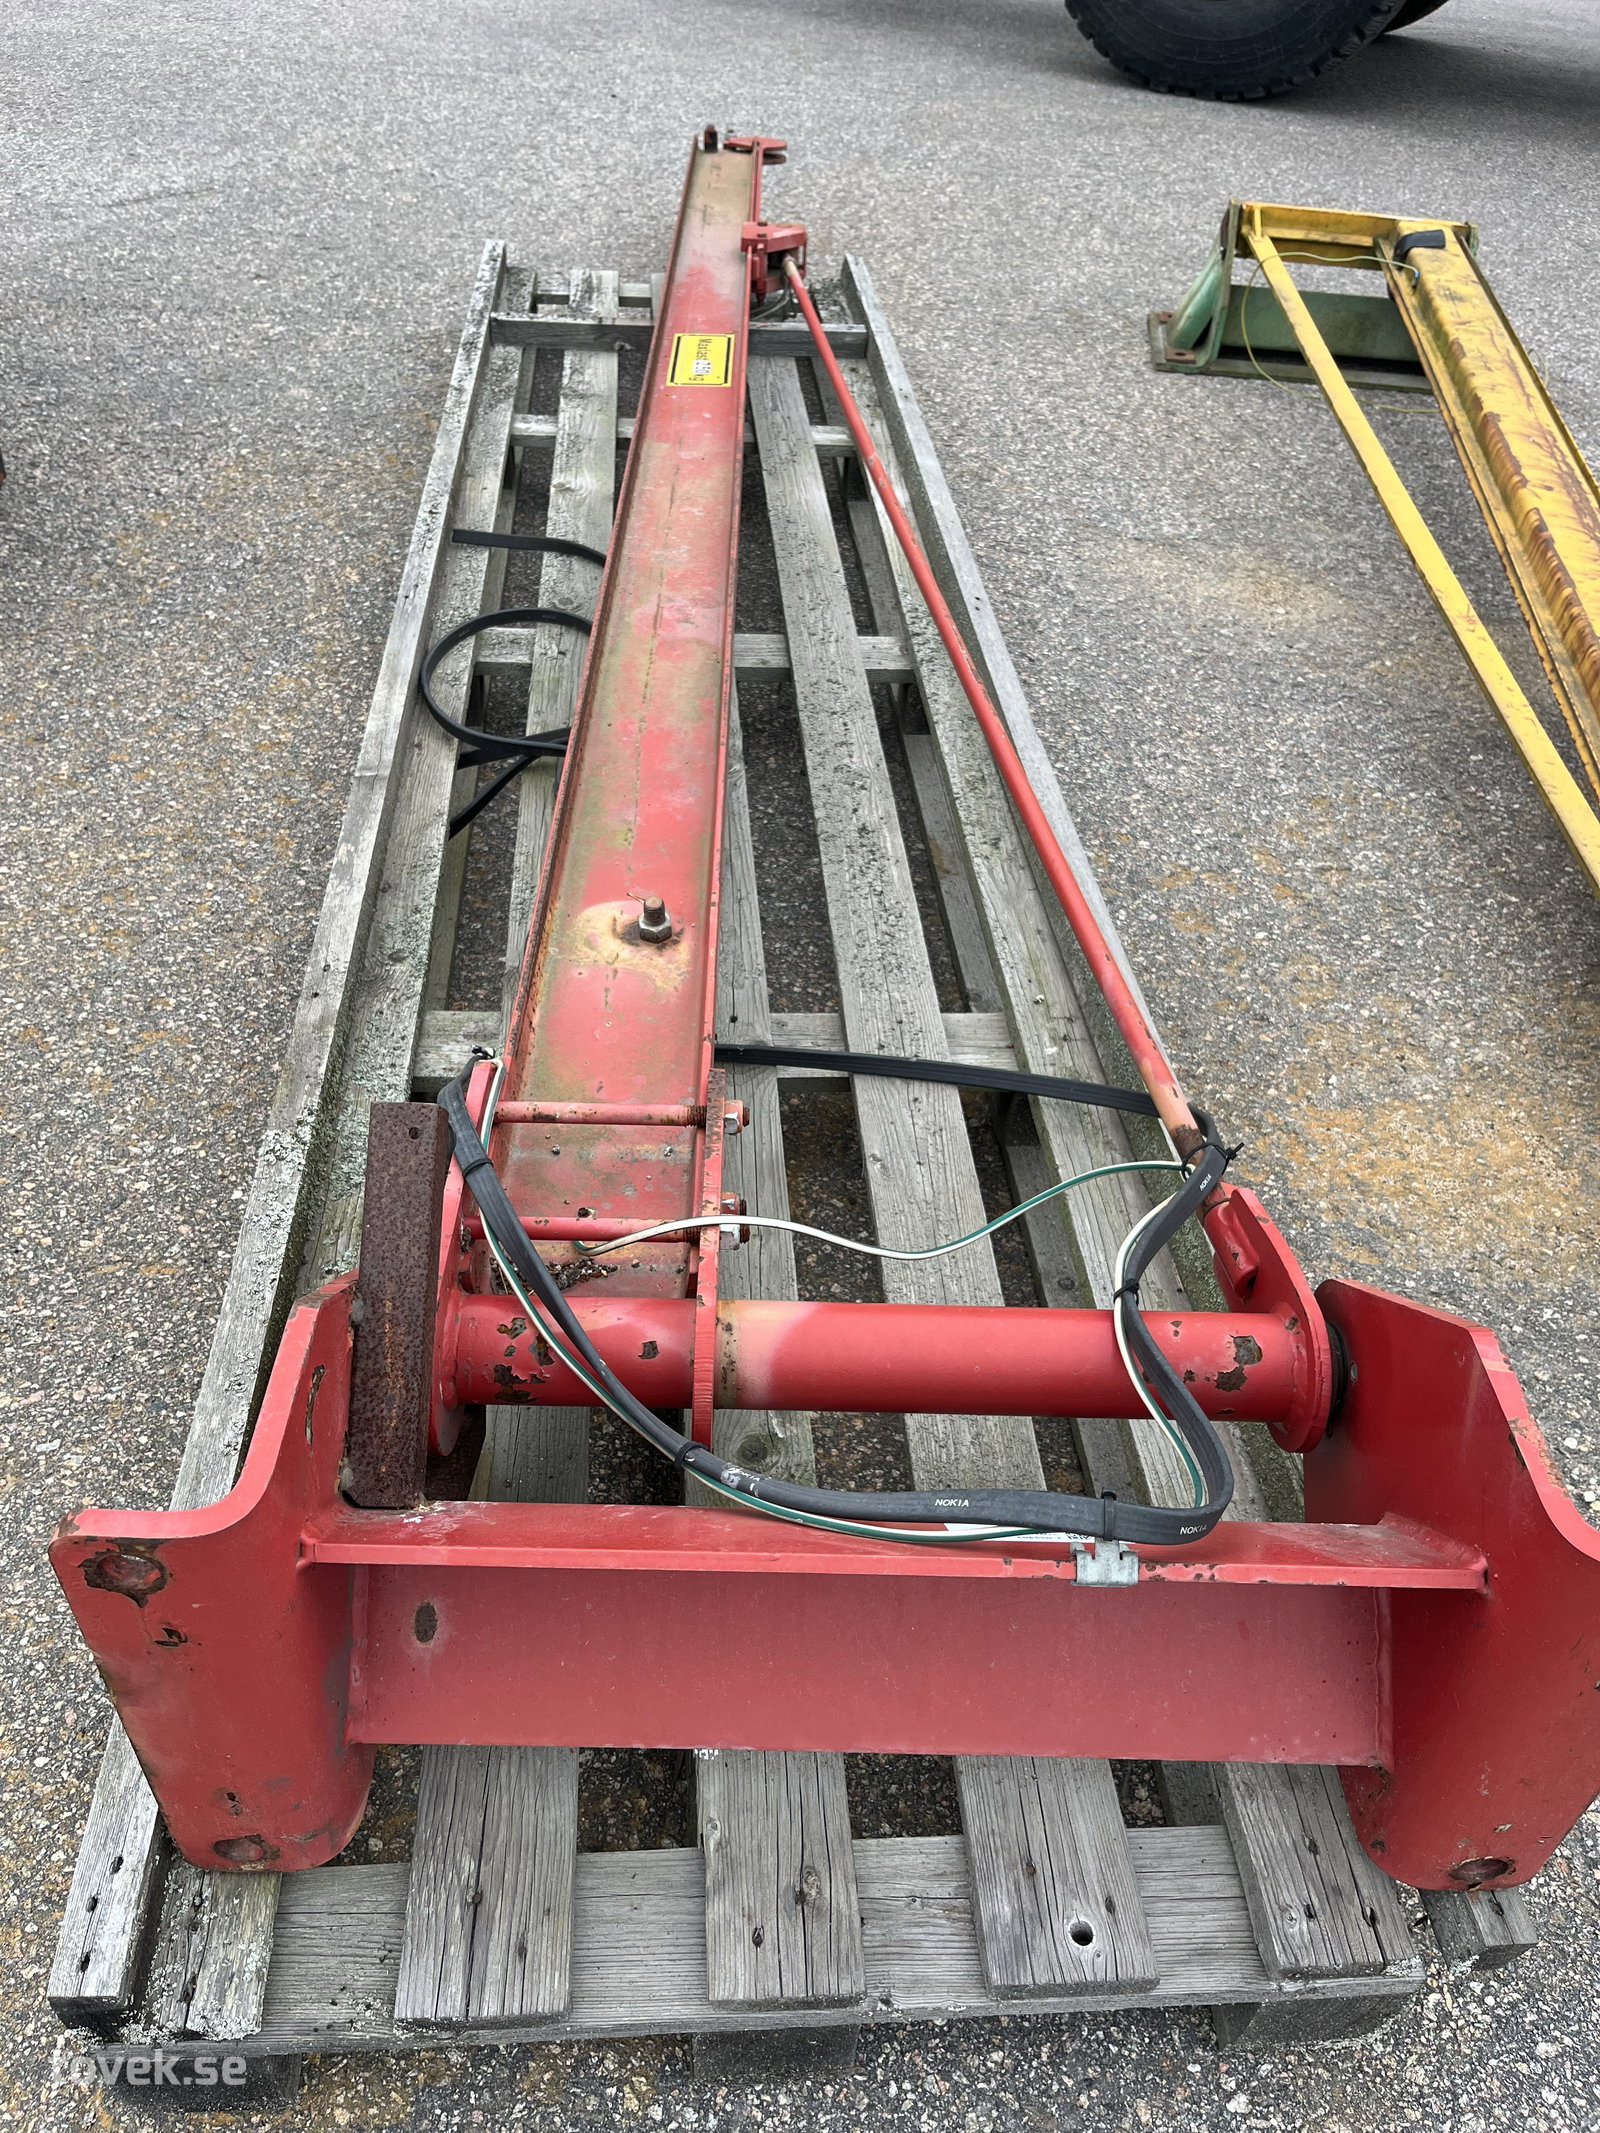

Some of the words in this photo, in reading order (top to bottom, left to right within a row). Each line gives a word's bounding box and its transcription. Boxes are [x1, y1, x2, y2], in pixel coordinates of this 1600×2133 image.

[694, 362, 711, 373] 250
[1199, 1173, 1212, 1191] NOKIA
[934, 1498, 969, 1508] NOKIA
[1179, 1524, 1207, 1535] NOKIA
